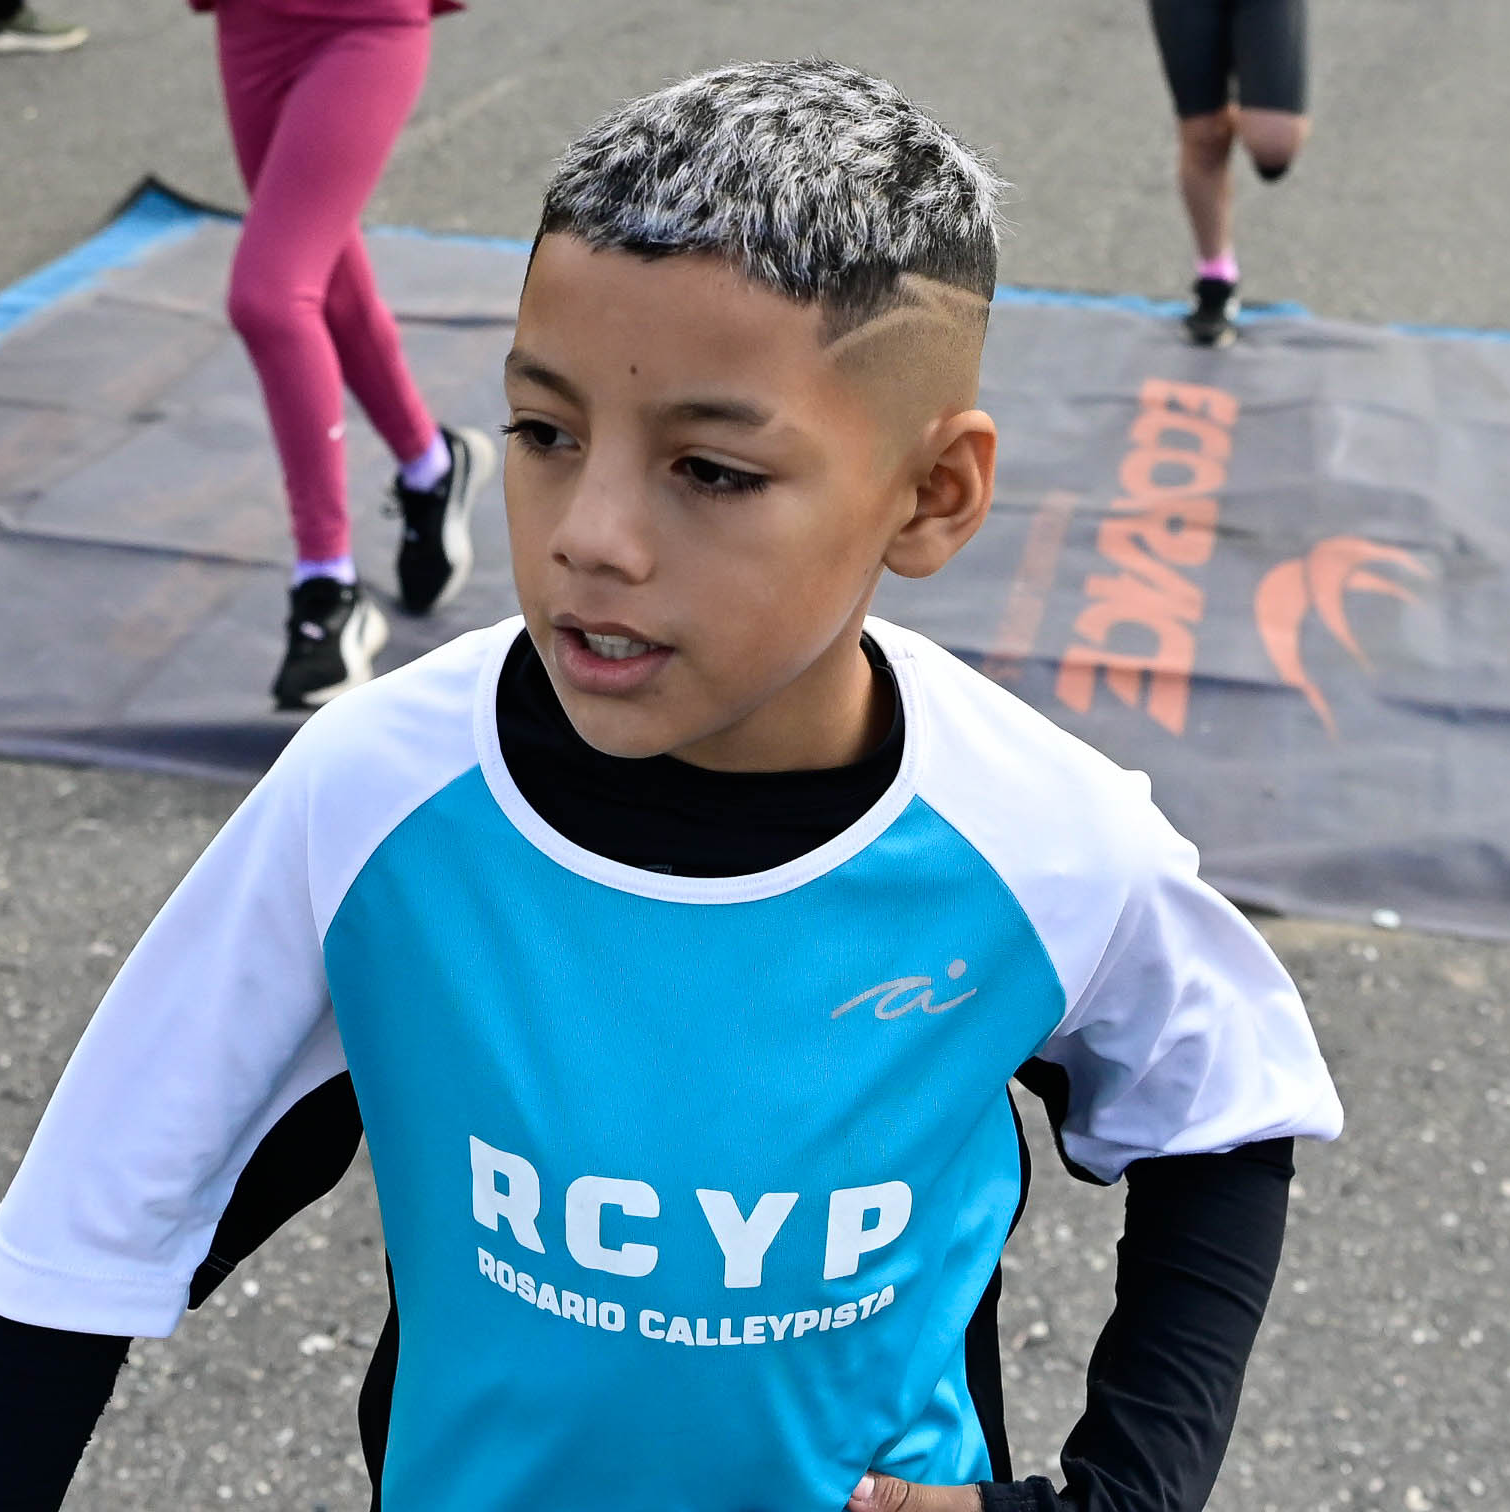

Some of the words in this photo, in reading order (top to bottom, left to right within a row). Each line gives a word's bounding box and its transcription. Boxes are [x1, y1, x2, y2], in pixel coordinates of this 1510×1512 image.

[1054, 378, 1240, 738] ECORACE
[469, 1134, 912, 1288] RCYP
[477, 1246, 626, 1332] ROSARIO
[638, 1284, 895, 1346] CALLEYPISTA
